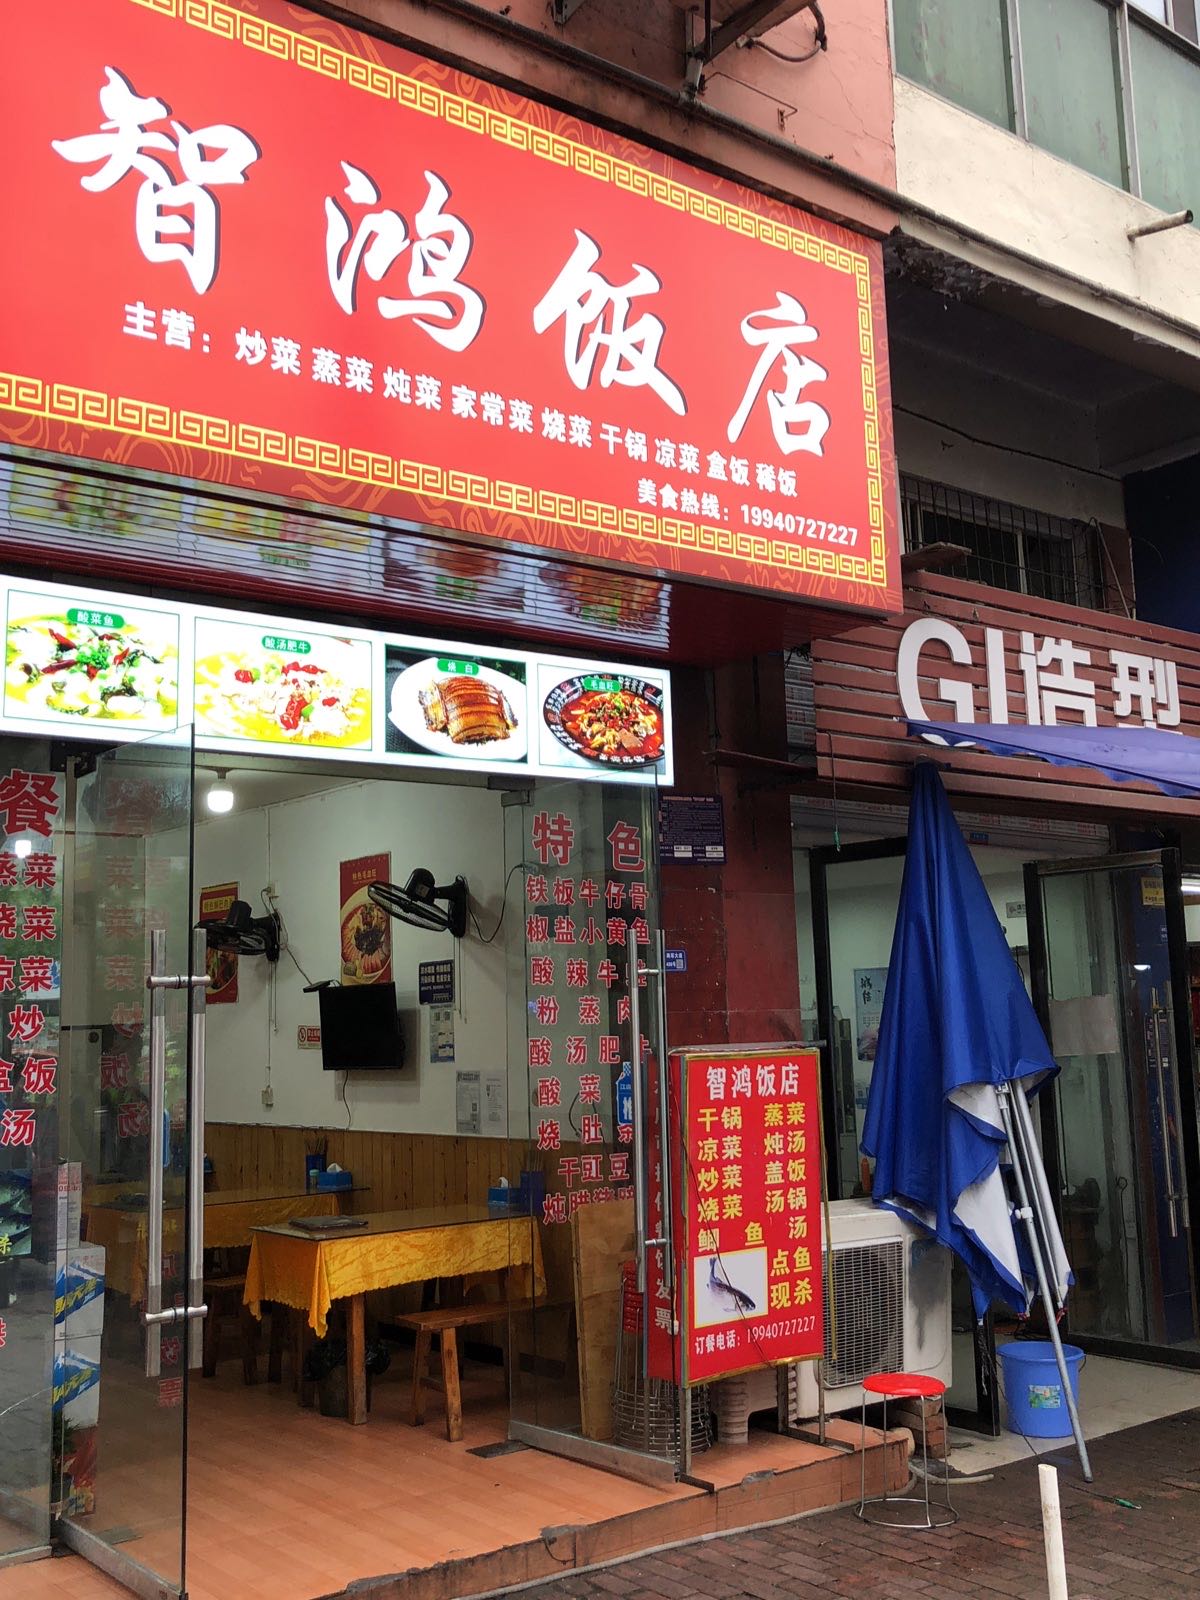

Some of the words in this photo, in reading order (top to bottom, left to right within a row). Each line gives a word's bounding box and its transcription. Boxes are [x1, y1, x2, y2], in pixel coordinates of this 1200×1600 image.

[51, 66, 833, 458] 智鸿饭店
[234, 328, 301, 376] 炒菜
[312, 346, 374, 394] 蒸菜
[383, 367, 442, 411] 炖菜
[451, 385, 534, 434] 家常菜
[541, 407, 593, 449] 烧菜
[600, 423, 649, 463] 干锅
[655, 438, 700, 474] 凉菜
[706, 451, 751, 488] 盒饭
[756, 463, 798, 498] 稀饭
[76, 609, 115, 628] 酸菜鱼
[264, 635, 310, 654] 酸汤肥牛
[1, 768, 60, 839] 餐
[532, 811, 646, 873] 特色
[526, 874, 649, 911] 铁板牛仔骨
[526, 914, 651, 947] 椒盐小黄鱼
[8, 1004, 45, 1042] 炒
[706, 1063, 800, 1100] 智鸿饭店
[1, 1108, 36, 1147] 汤
[697, 1106, 743, 1132] 干锅
[764, 1101, 806, 1127] 蒸菜
[697, 1135, 743, 1163] 凉菜
[764, 1130, 806, 1156] 炖汤
[558, 1153, 630, 1188] 干豇豆
[697, 1164, 743, 1193] 炒菜
[764, 1158, 807, 1185] 盖饭
[697, 1194, 743, 1223] 烧菜
[765, 1187, 807, 1213] 汤锅
[770, 1246, 812, 1277] 点鱼
[770, 1278, 813, 1310] 现杀
